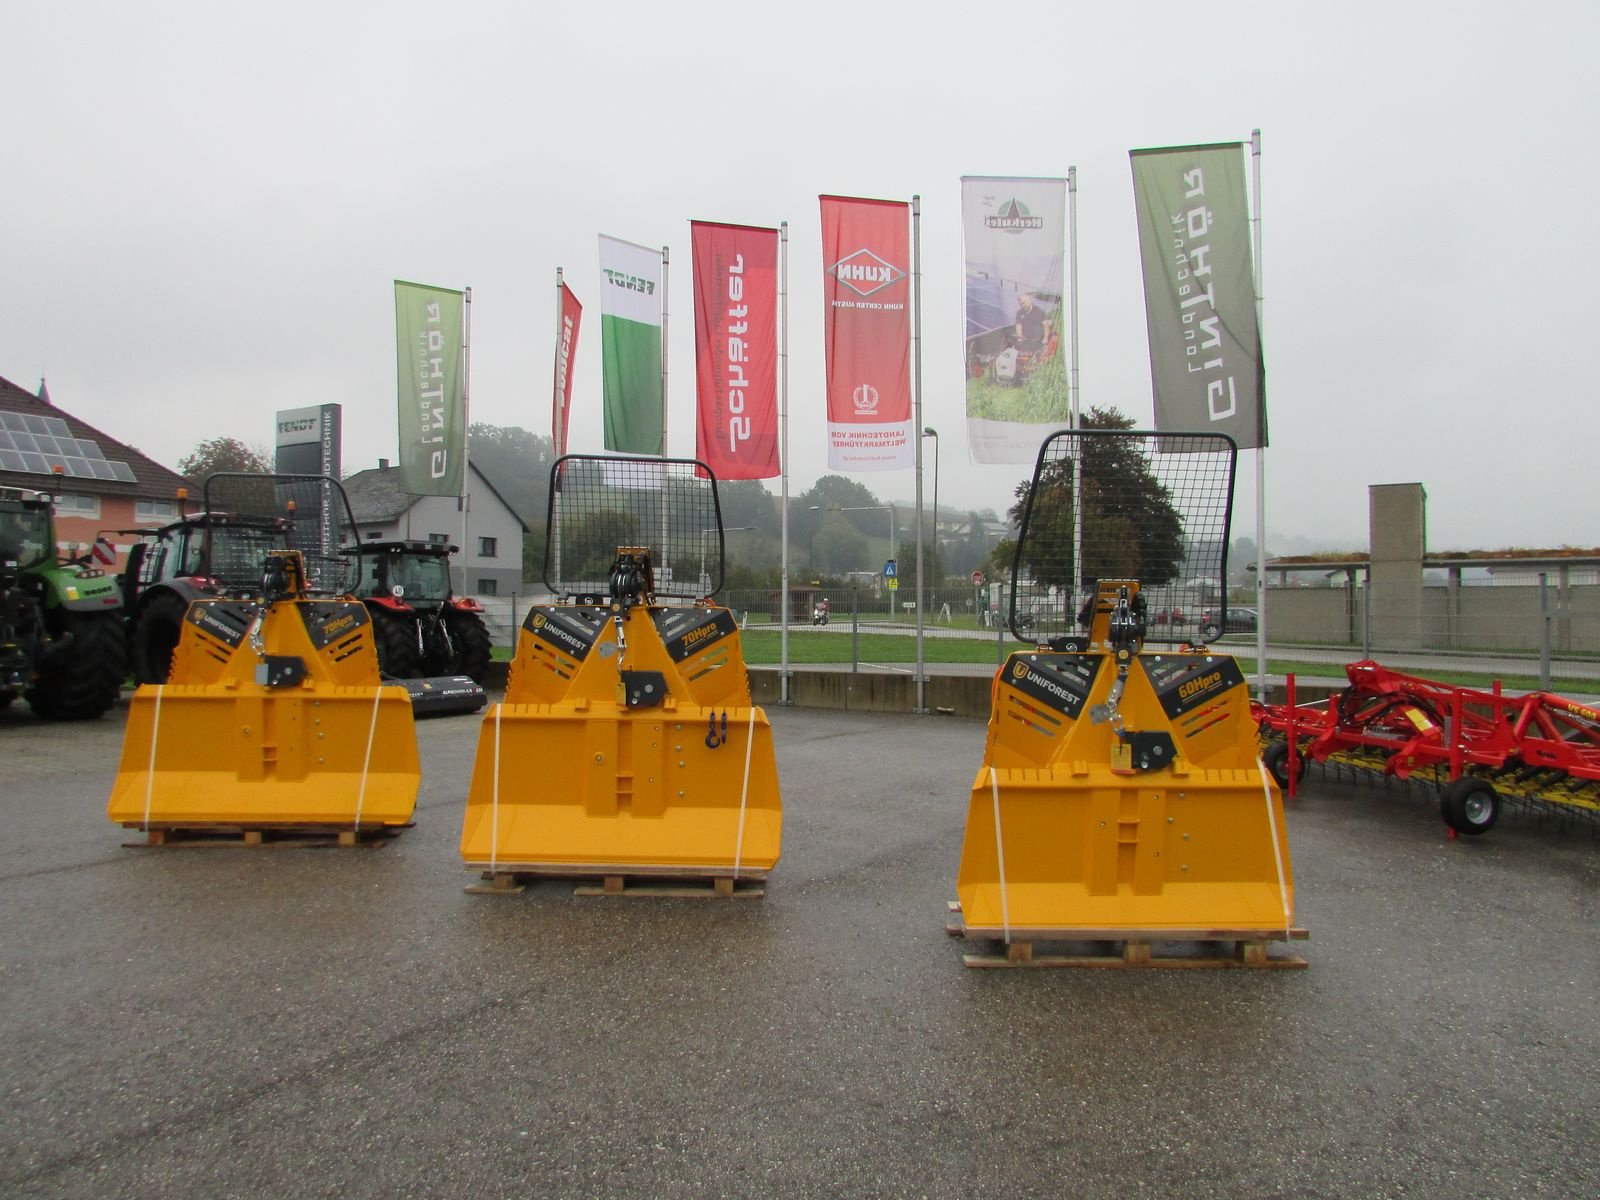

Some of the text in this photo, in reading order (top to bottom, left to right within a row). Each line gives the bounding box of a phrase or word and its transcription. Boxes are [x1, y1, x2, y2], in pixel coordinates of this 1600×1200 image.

[278, 418, 317, 433] FENDT
[203, 614, 241, 639] UNIFOREST
[543, 622, 587, 651] UNIFOREST
[681, 622, 717, 646] 70Hpro
[1026, 670, 1081, 705] UNIFOREST
[1178, 671, 1222, 698] 60Hpro
